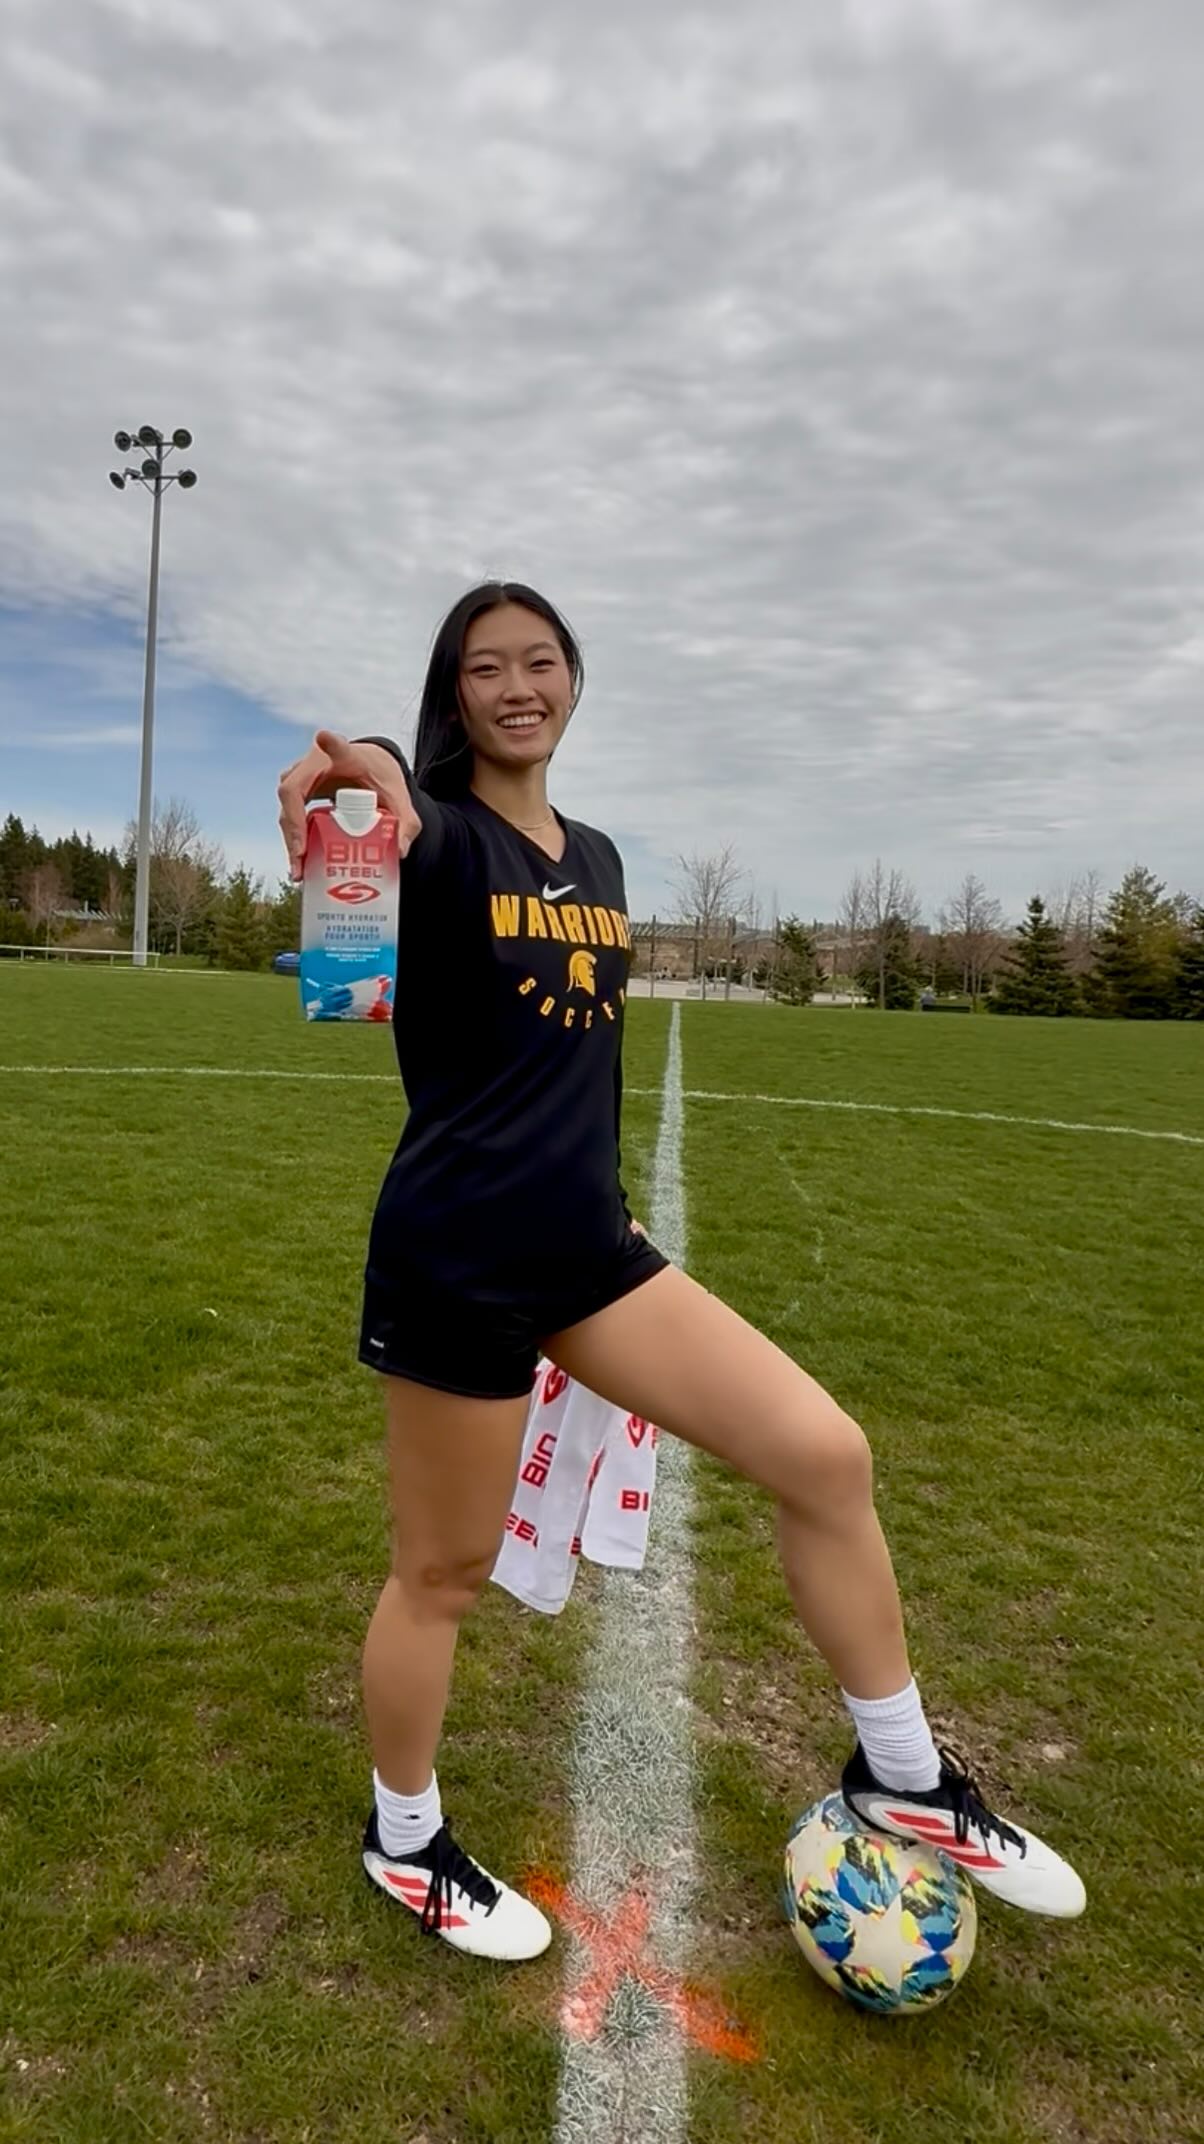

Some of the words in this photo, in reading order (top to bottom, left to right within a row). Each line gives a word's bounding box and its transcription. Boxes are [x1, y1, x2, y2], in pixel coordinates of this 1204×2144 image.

[326, 841, 383, 865] BIO
[326, 866, 383, 878] STEEL
[491, 894, 632, 950] WARRIOR
